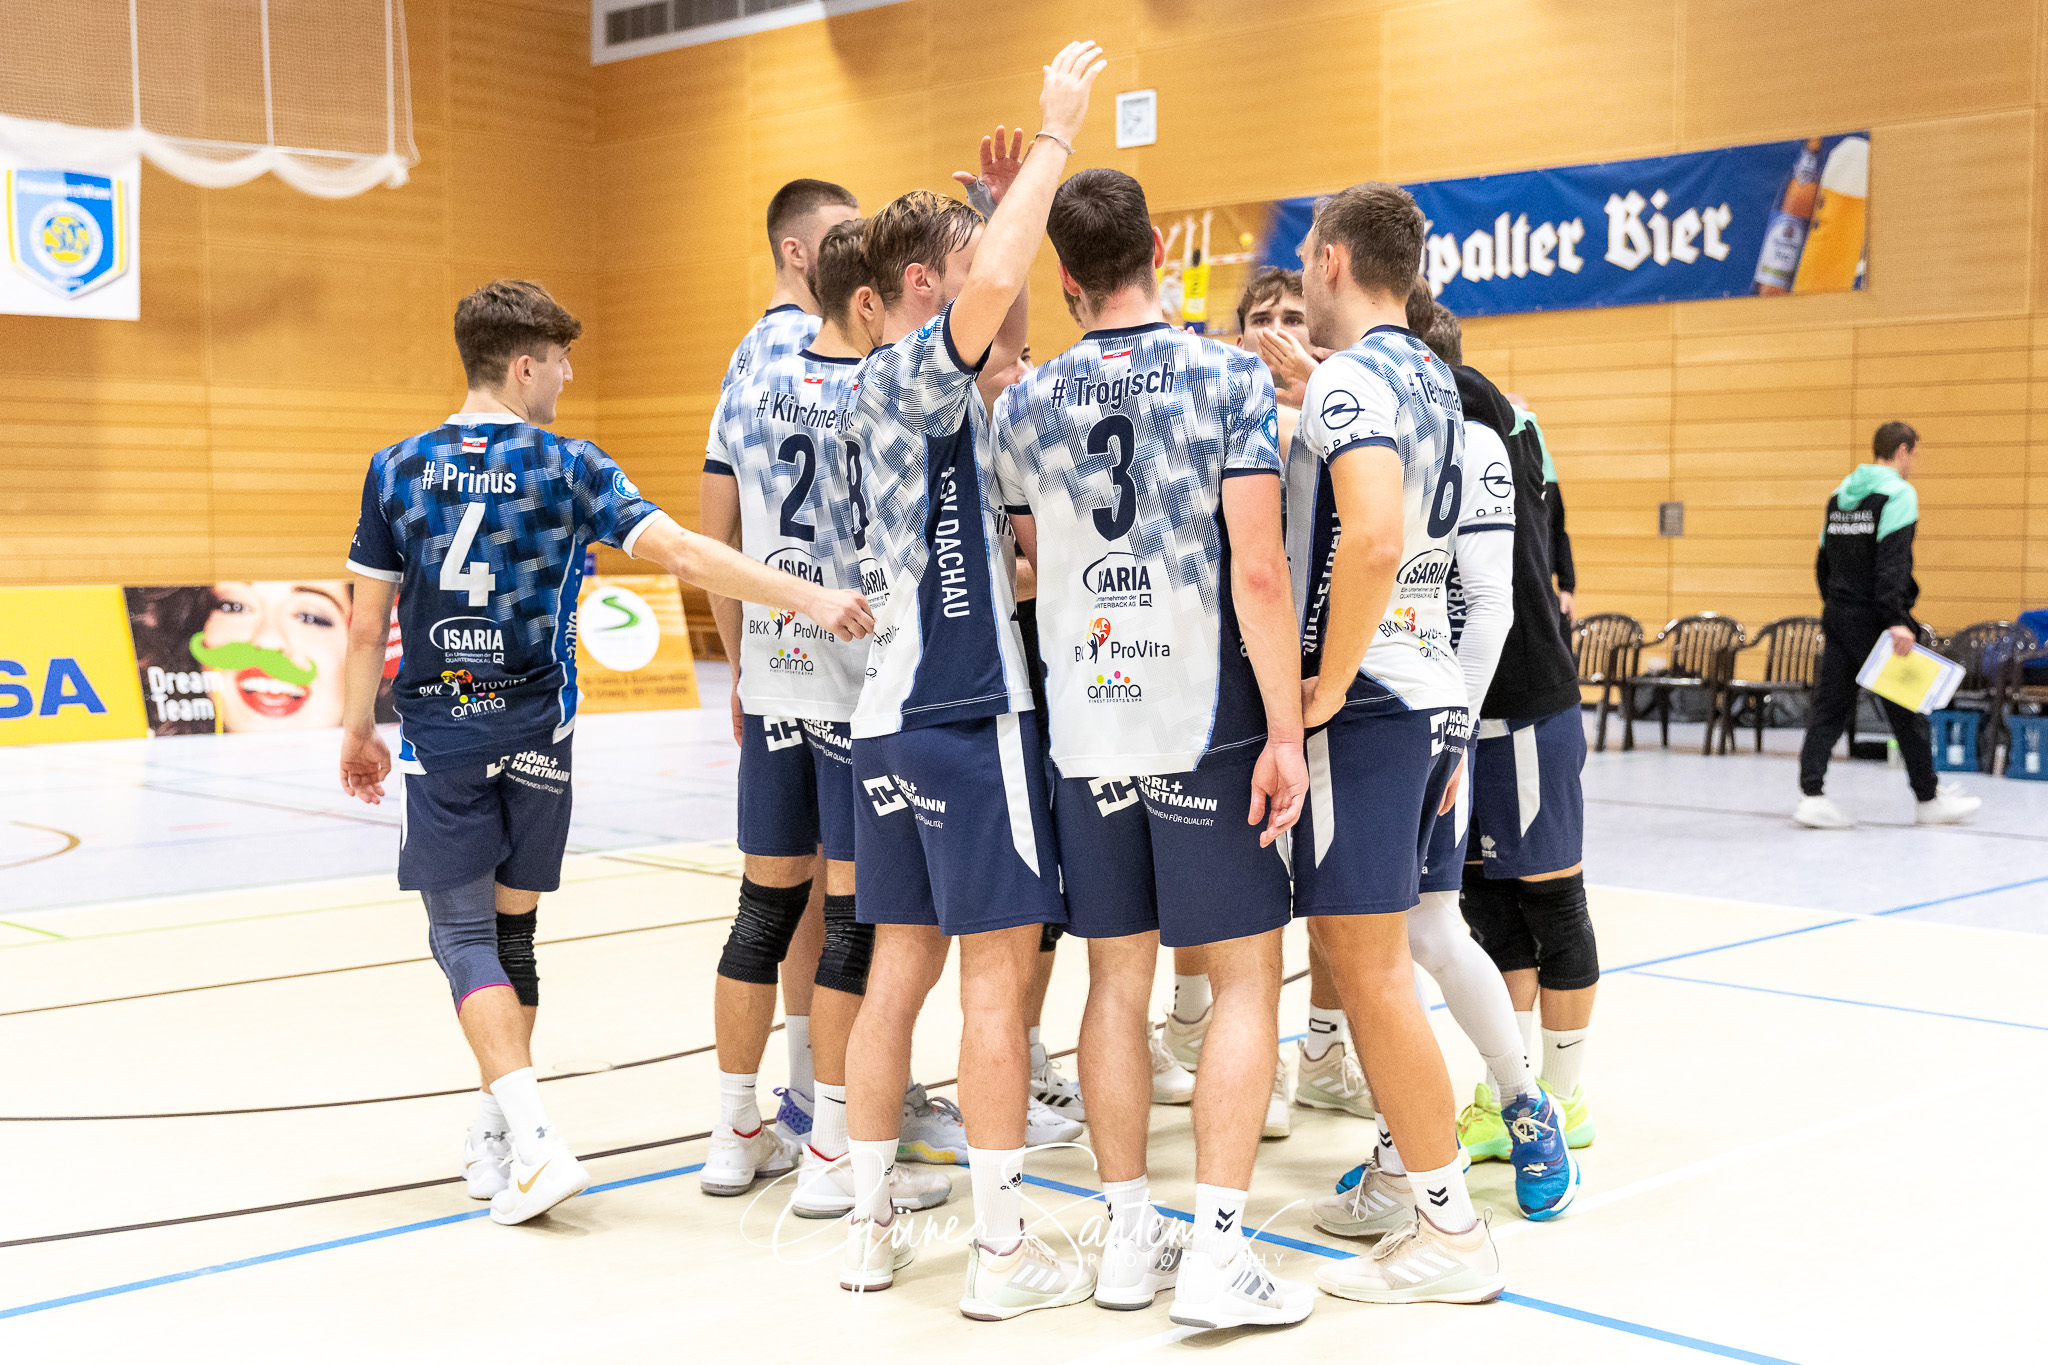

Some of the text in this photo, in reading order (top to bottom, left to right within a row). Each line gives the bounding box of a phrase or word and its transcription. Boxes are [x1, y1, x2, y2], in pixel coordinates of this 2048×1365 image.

[1604, 188, 1733, 270] Bier
[1051, 362, 1176, 410] # Trogisch
[756, 391, 769, 418] #
[772, 392, 840, 429] Kirchne
[422, 461, 517, 494] # Prinus
[777, 433, 816, 543] 2
[1086, 414, 1137, 542] 3
[1427, 418, 1462, 539] 6
[439, 501, 496, 607] 4
[935, 518, 971, 618] DACHAU
[1403, 562, 1449, 585] ISARIA
[443, 628, 505, 651] ISARIA
[749, 619, 770, 635] BKK
[1110, 639, 1171, 660] ProVita
[769, 657, 814, 672] anima
[147, 666, 226, 695] Dream
[1087, 684, 1142, 699] anima
[151, 693, 216, 723] Team
[451, 697, 506, 718] anima
[514, 750, 559, 769] HÖRL+
[1168, 813, 1183, 824] FÜR
[1183, 816, 1215, 827] QUALITÄT
